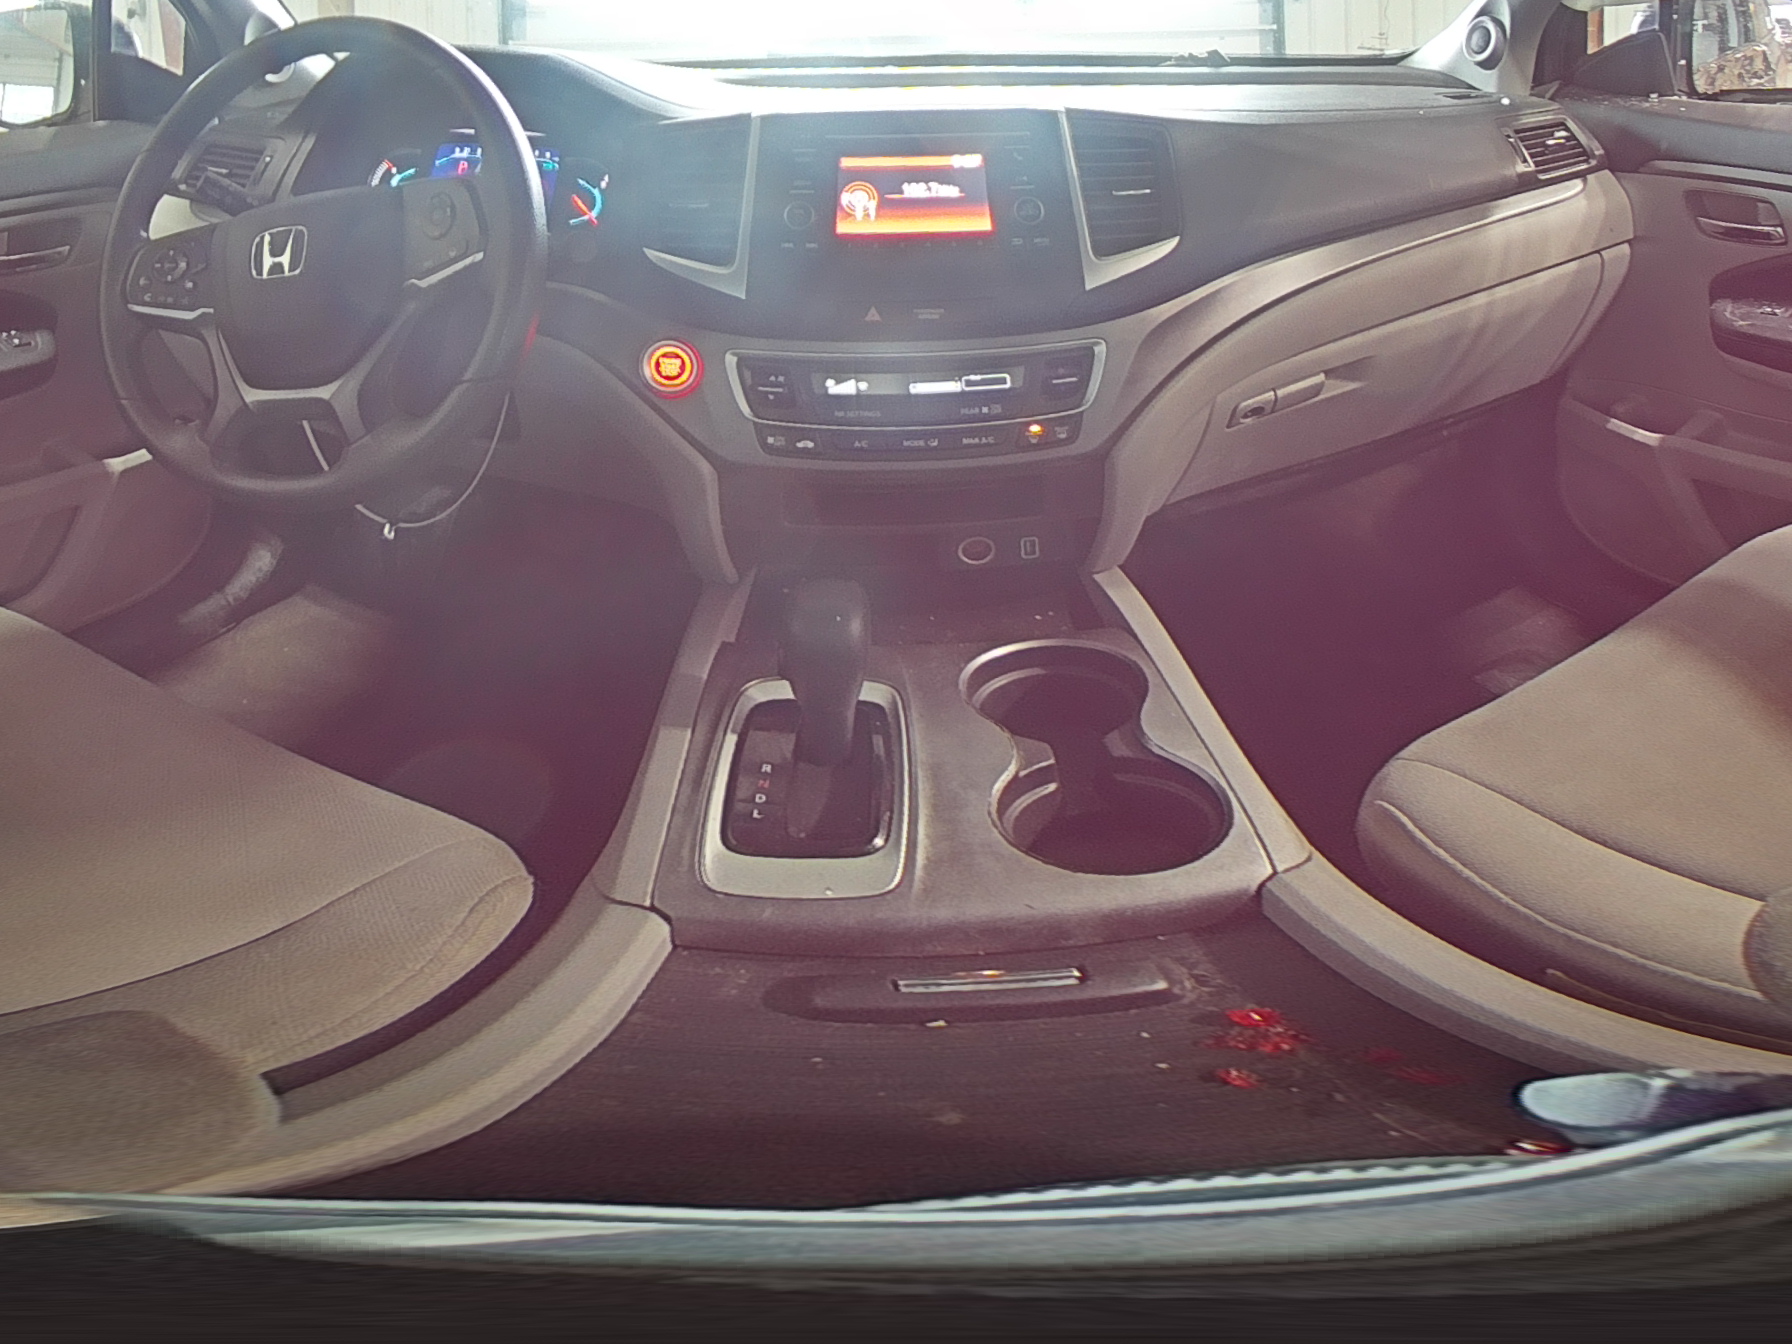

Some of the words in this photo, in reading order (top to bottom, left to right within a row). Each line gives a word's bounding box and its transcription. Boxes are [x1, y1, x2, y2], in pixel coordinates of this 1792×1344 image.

[760, 763, 772, 774] R
[755, 793, 766, 804] D
[752, 808, 765, 819] L
